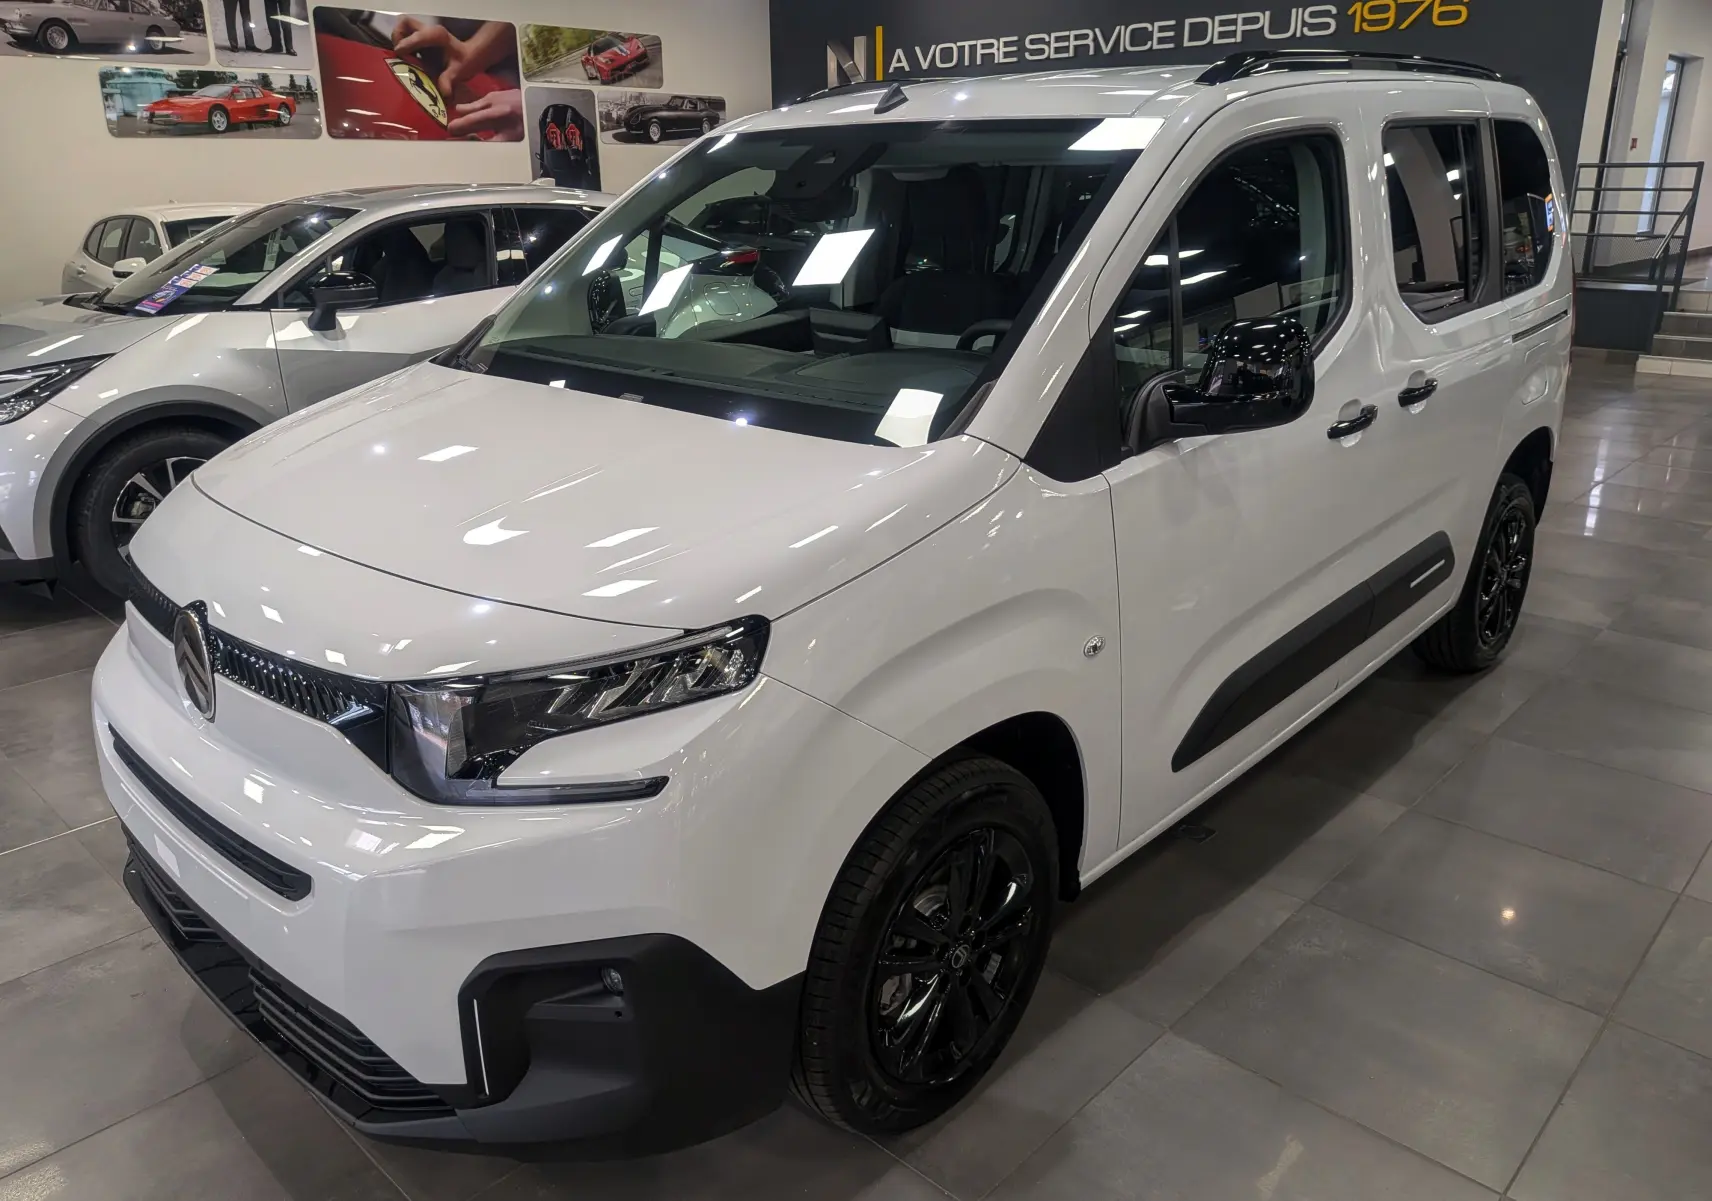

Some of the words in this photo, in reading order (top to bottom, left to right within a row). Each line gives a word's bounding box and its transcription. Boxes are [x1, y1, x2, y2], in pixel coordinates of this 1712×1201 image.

[888, 48, 910, 73] A
[915, 36, 1019, 70] VOTRE
[1024, 20, 1176, 61] SERVICE
[1183, 4, 1338, 47] DEPUIS
[1347, 0, 1470, 33] 1976
